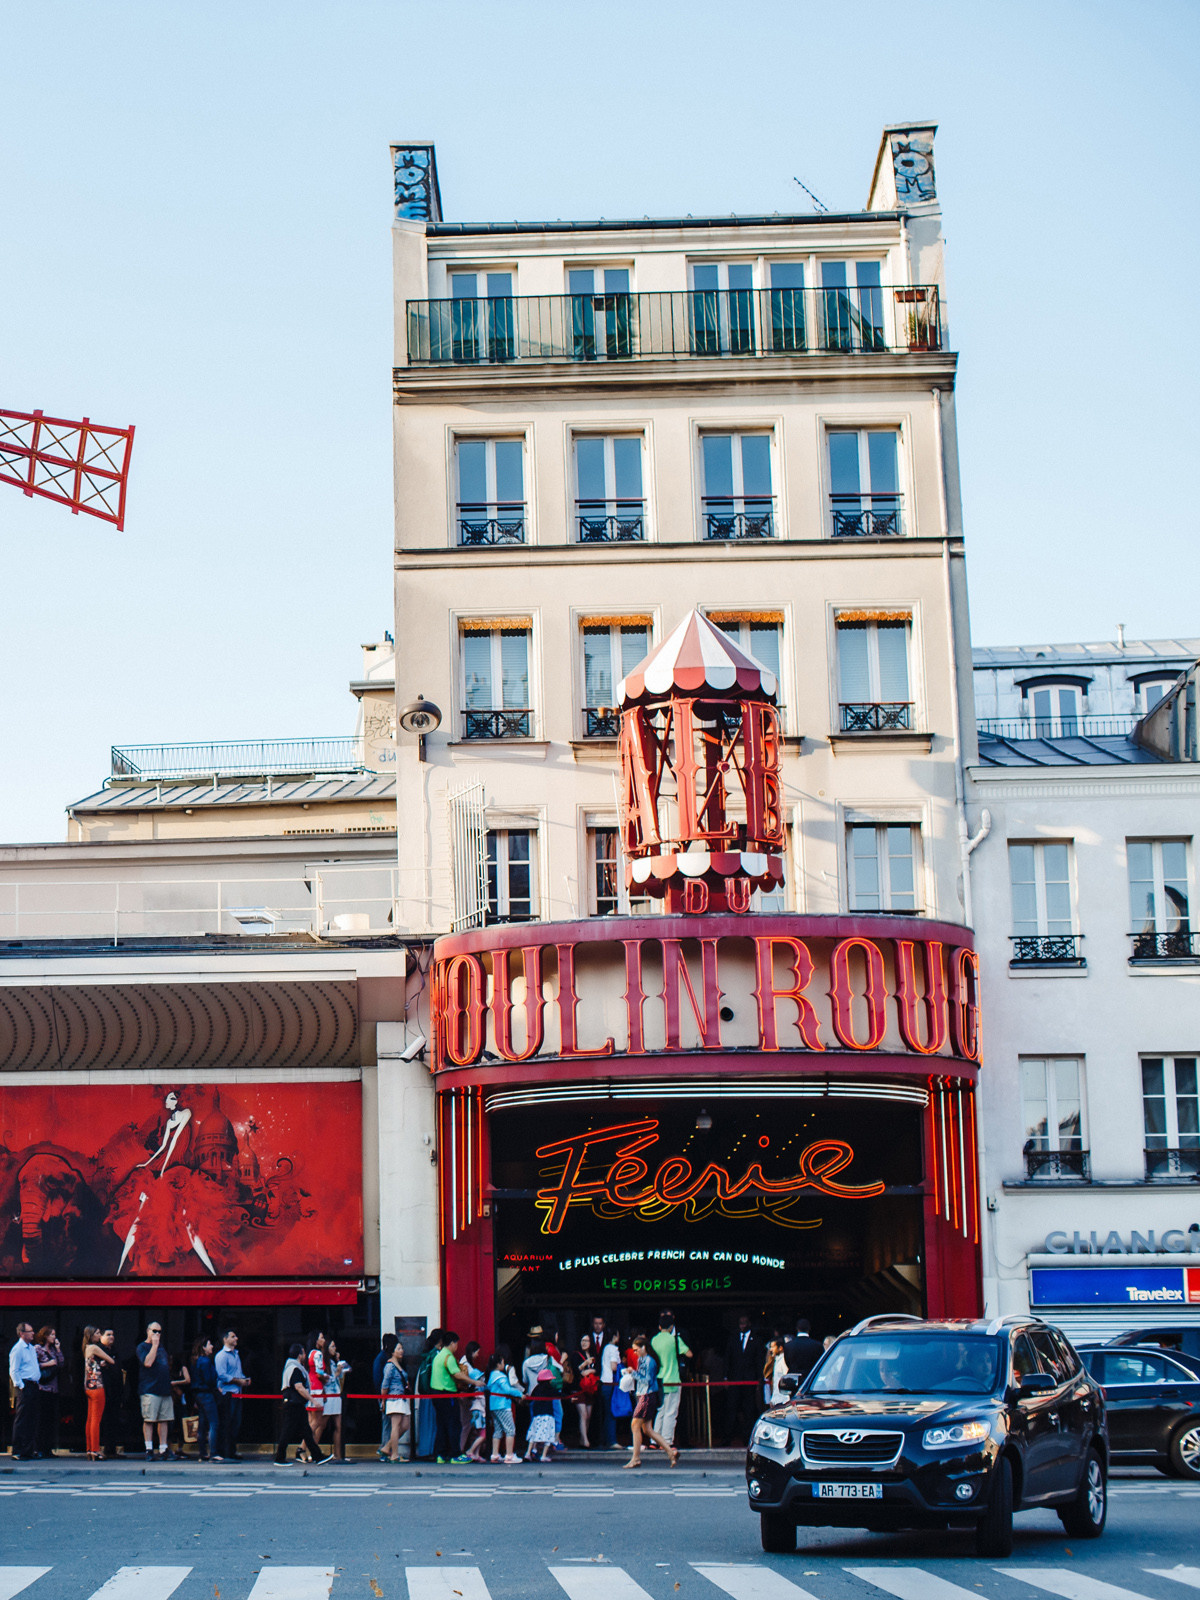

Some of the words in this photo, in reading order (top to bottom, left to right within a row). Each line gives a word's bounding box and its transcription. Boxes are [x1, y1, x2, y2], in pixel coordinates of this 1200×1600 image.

[681, 877, 751, 914] DU
[559, 1259, 572, 1270] LE
[574, 1255, 601, 1268] PLUS
[602, 1251, 645, 1264] CELEBRE
[647, 1250, 685, 1261] FRENCH
[689, 1251, 710, 1261] CAN
[712, 1251, 733, 1262] CAN
[734, 1253, 749, 1263] DU
[751, 1254, 786, 1270] MONDE
[603, 1278, 628, 1289] LES
[634, 1279, 687, 1291] DORISS
[691, 1275, 732, 1291] GIRLS
[1126, 1287, 1183, 1301] Travelex
[821, 1484, 875, 1497] AR-773-EA
